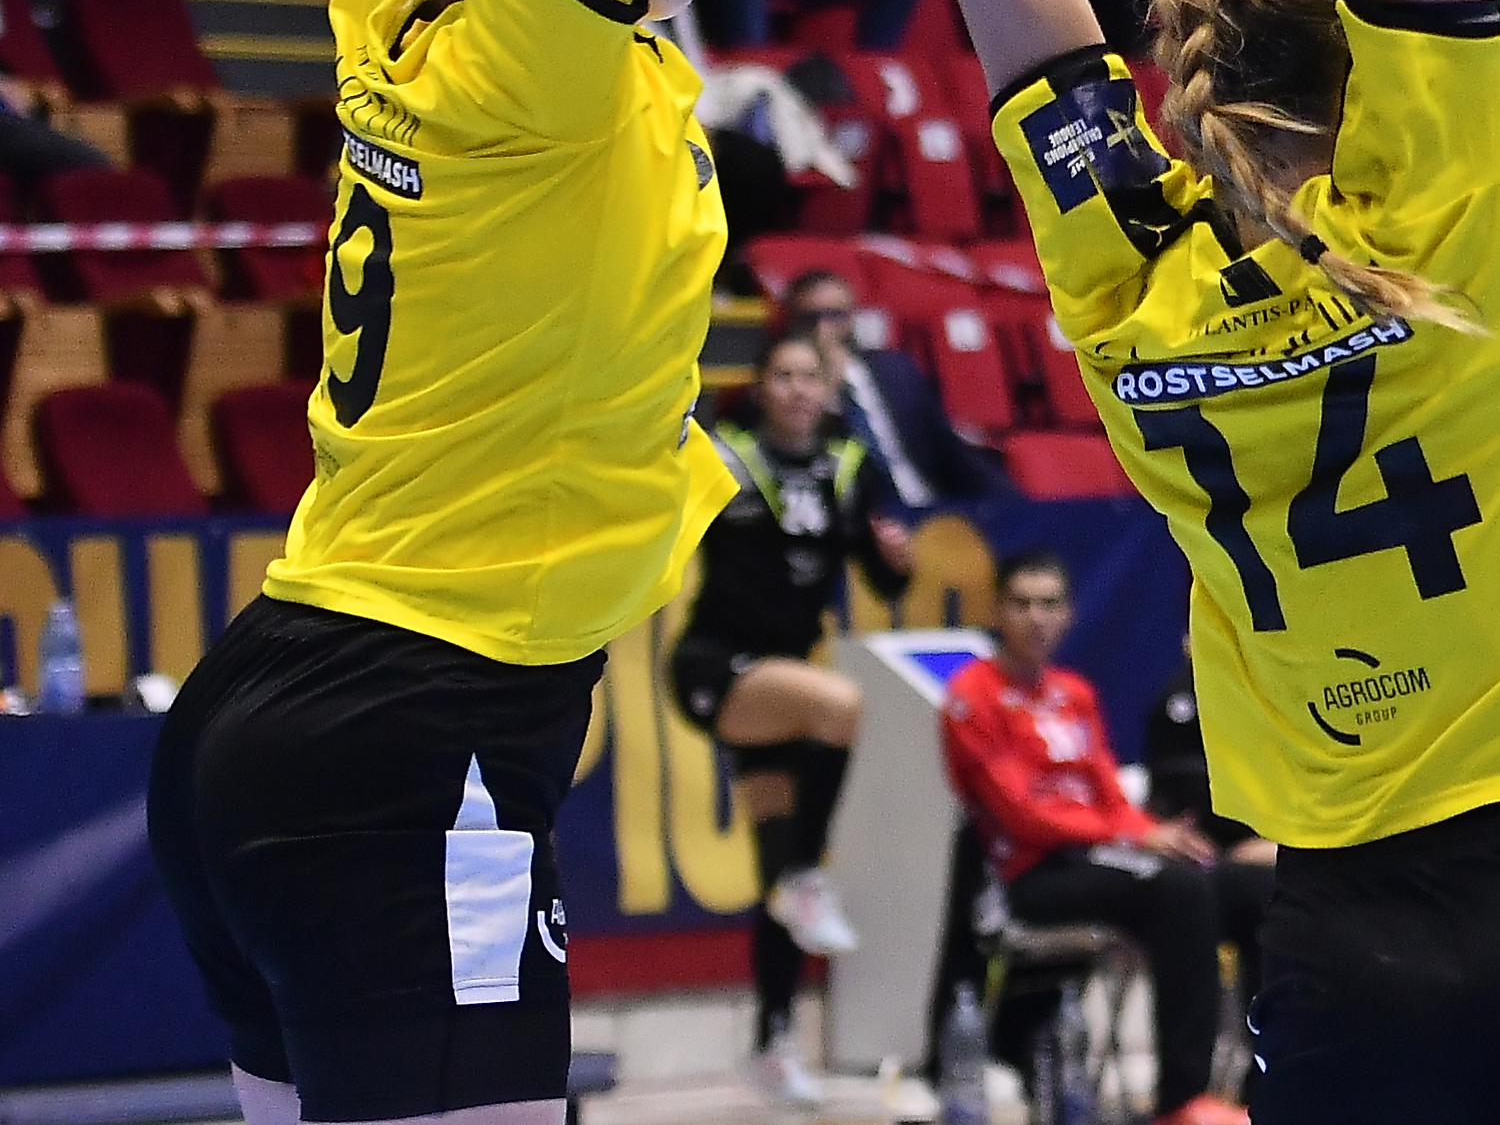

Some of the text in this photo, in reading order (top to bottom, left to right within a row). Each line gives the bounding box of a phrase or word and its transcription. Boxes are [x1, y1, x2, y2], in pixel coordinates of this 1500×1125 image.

[1043, 126, 1103, 166] CHAMPIONS
[1048, 118, 1089, 148] LEAGUE
[344, 132, 421, 193] SELMASH
[329, 182, 395, 429] 9
[1116, 316, 1407, 400] ROSTSELMASH
[1132, 353, 1483, 632] 14
[1323, 667, 1431, 711] AGROCOM
[1355, 706, 1397, 726] GROUP
